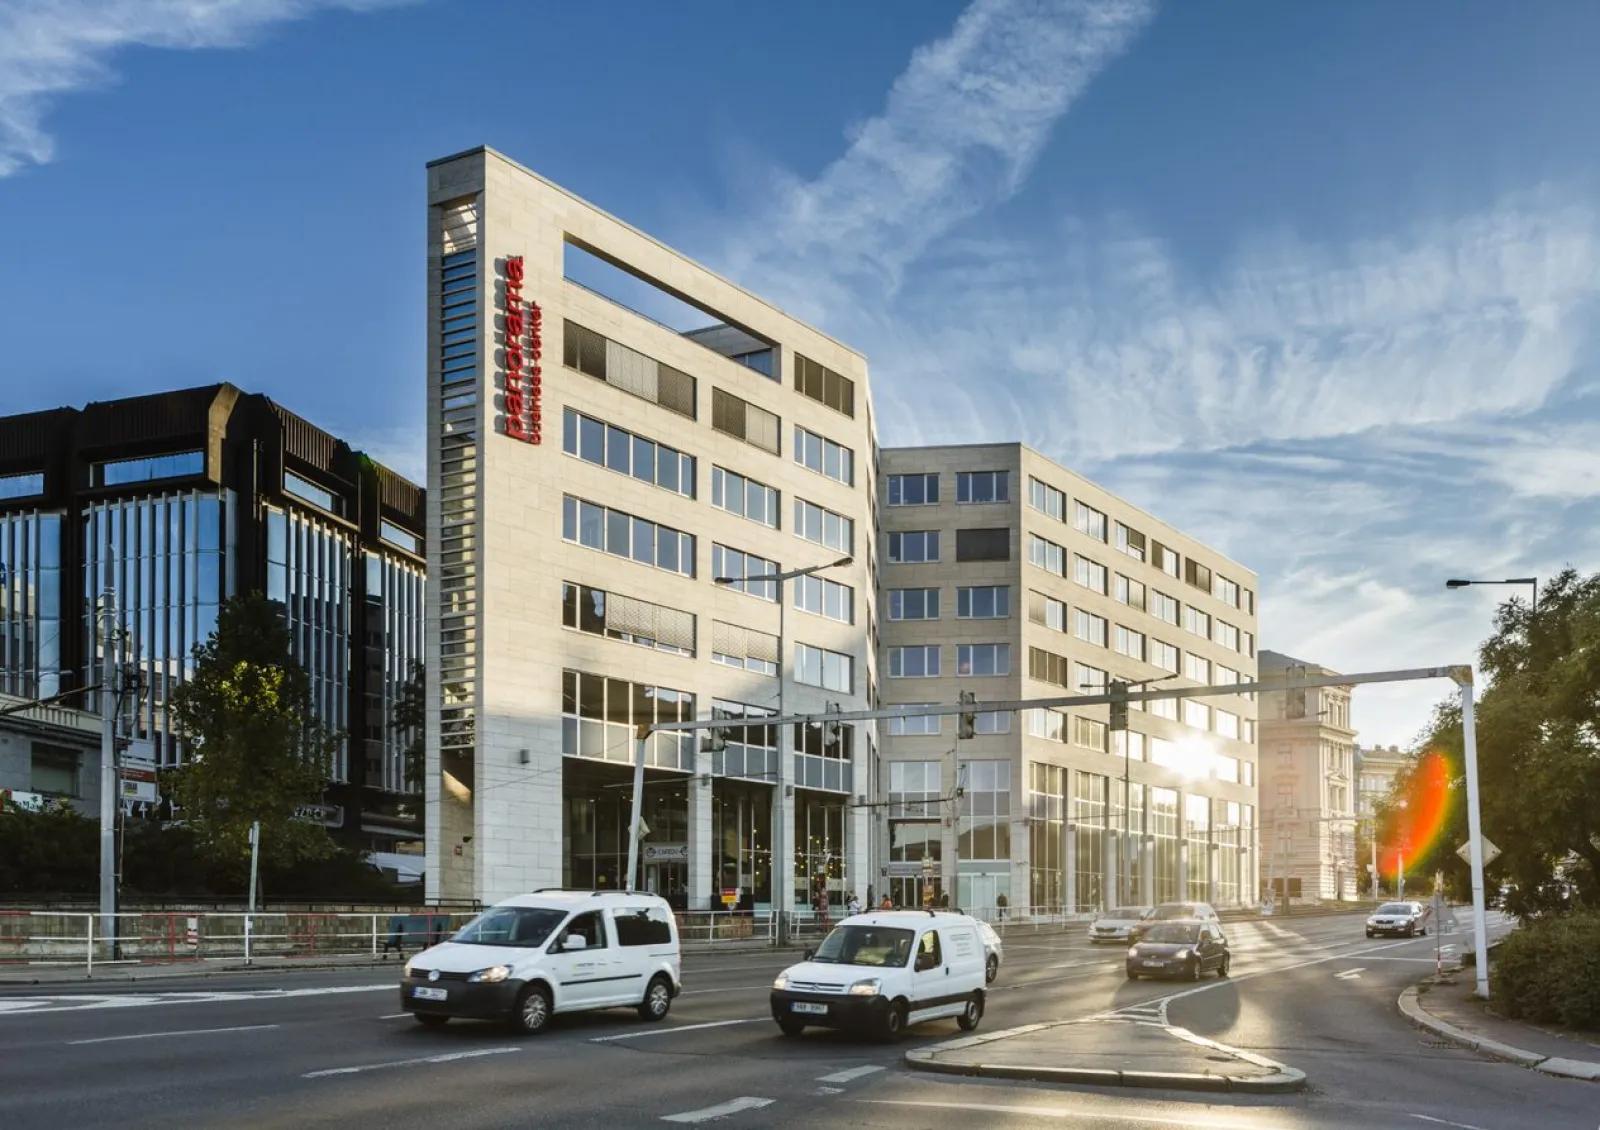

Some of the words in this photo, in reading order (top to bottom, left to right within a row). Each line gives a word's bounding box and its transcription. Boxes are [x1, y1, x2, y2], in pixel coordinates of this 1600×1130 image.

[506, 256, 529, 441] panorama
[530, 301, 542, 361] center
[530, 366, 542, 446] business
